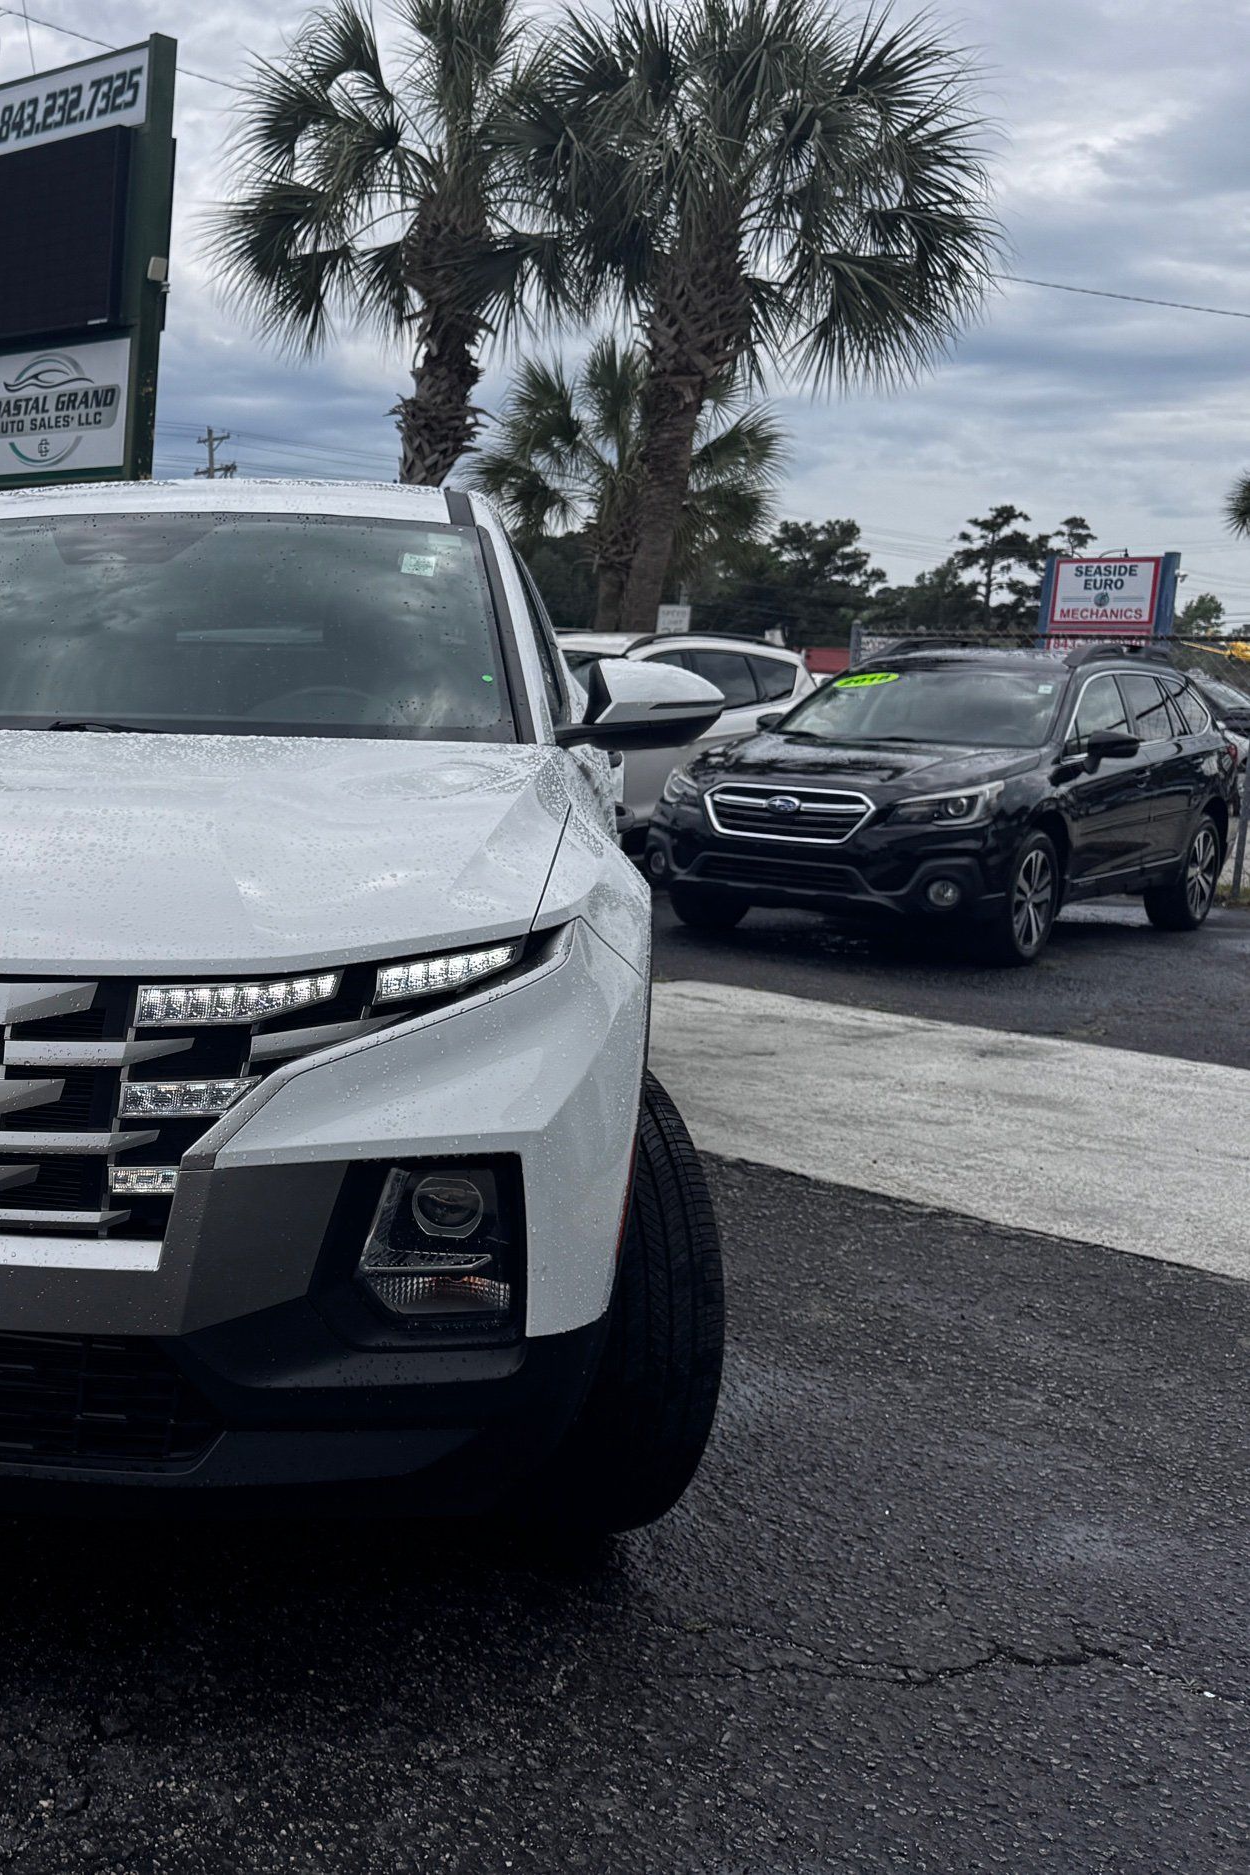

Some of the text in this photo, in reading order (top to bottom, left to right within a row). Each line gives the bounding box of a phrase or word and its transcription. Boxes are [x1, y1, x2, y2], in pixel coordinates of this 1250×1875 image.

[55, 388, 116, 412] GRAND
[78, 411, 102, 427] LLC
[1074, 564, 1138, 577] SEASIDE
[1083, 578, 1124, 590] EURO
[1059, 607, 1143, 620] MECHANICS
